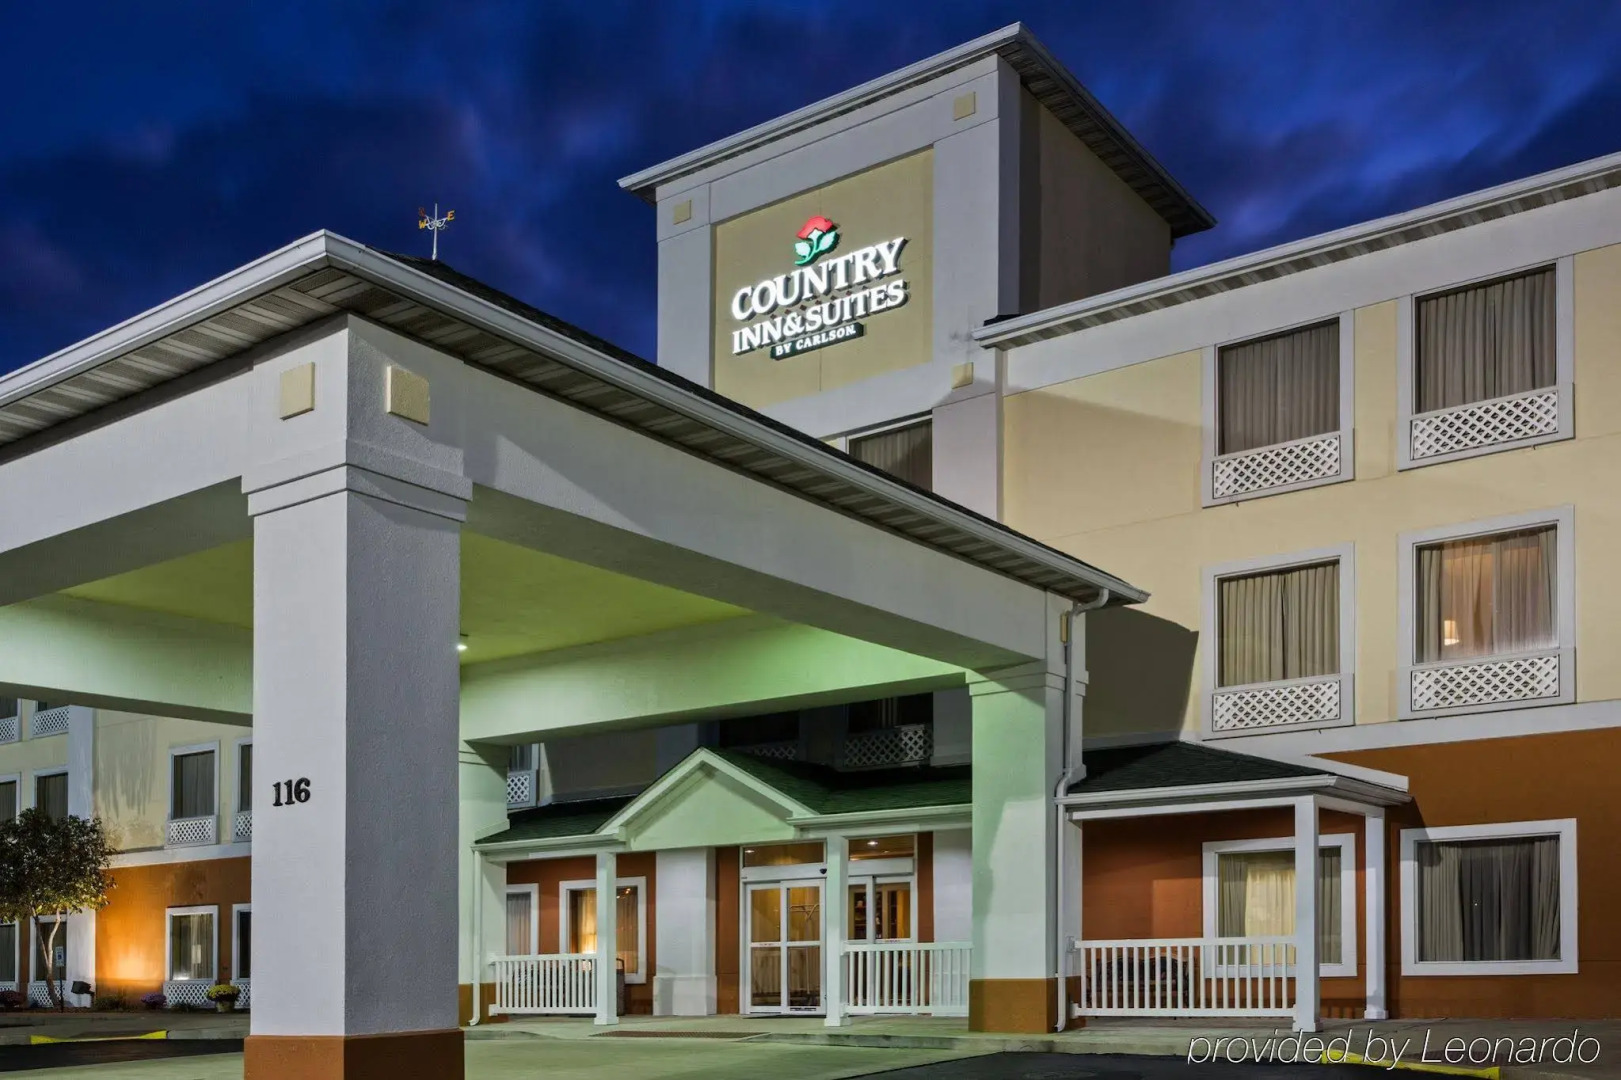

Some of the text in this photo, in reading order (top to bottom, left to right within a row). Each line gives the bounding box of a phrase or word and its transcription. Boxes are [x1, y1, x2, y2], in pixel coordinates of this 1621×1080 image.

[731, 237, 905, 320] COUNTRY
[775, 325, 856, 356] BY CARLSON
[272, 777, 311, 807] 116
